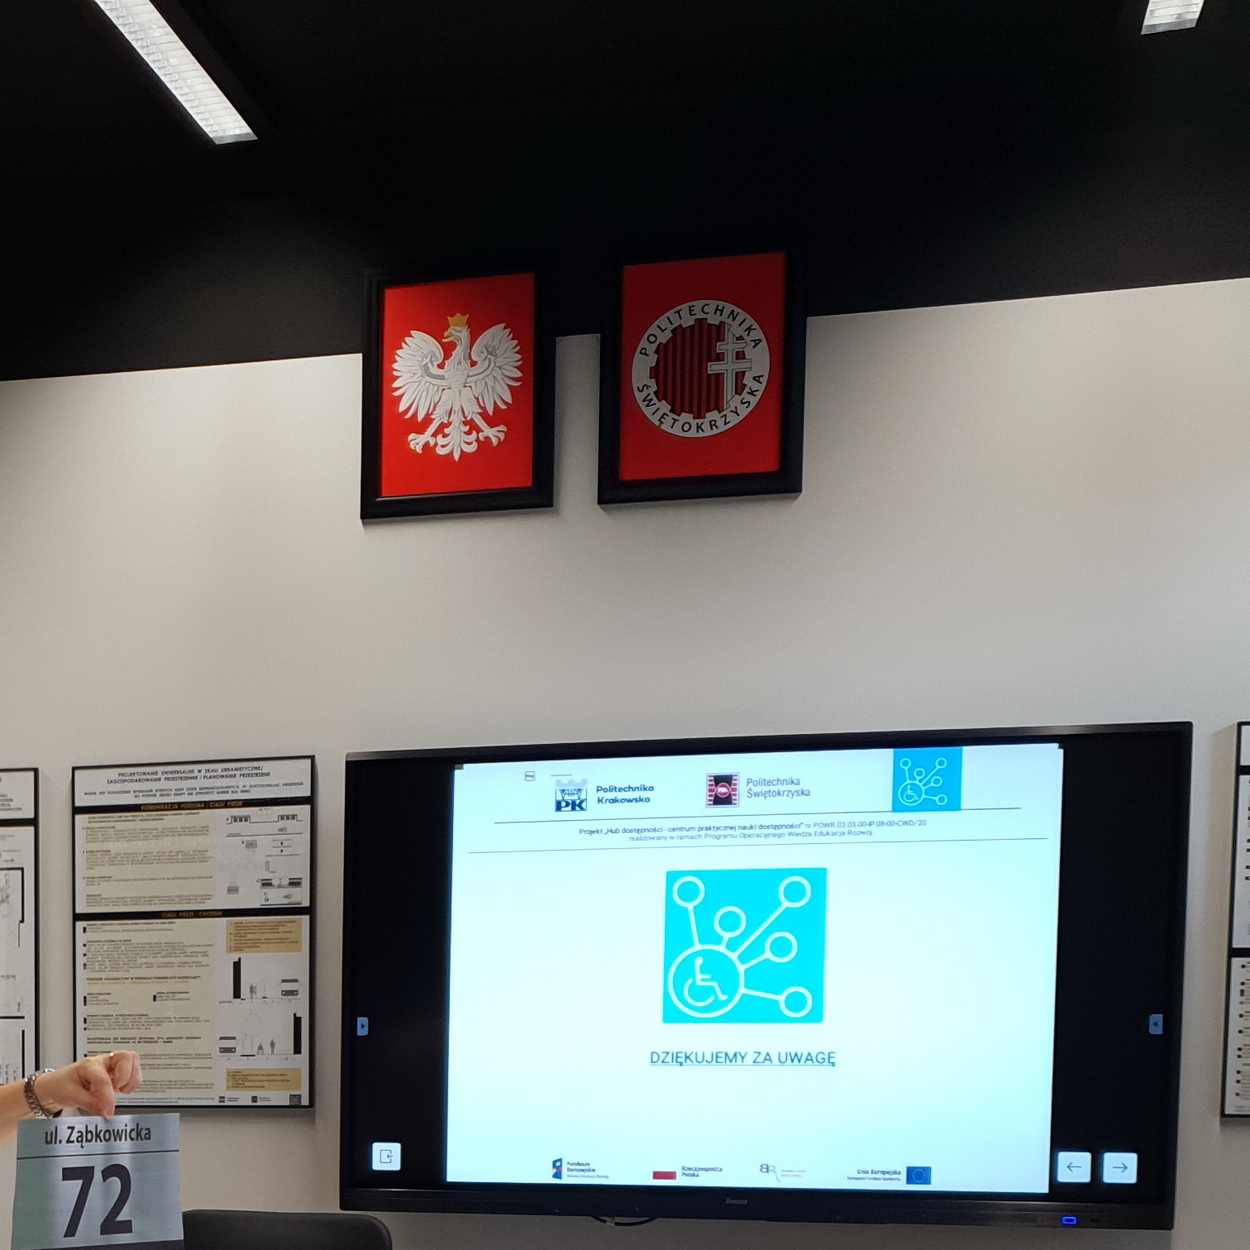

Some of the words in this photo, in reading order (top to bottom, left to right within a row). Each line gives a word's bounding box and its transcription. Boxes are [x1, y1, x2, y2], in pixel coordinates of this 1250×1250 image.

[639, 303, 763, 358] POLITECHNIKA
[637, 373, 765, 433] ŚWIĘTOKRZYSKA
[746, 776, 801, 787] Politechnika
[596, 784, 654, 794] Politechnika
[746, 786, 811, 800] Świętokrzyska
[556, 799, 587, 811] PK
[597, 795, 651, 805] Krakowska
[579, 828, 603, 836] Projekt
[697, 825, 737, 834] praktycznej
[738, 823, 757, 831] nauki
[650, 1051, 747, 1067] DZIĘKUJEMY
[752, 1051, 773, 1065] ZA
[778, 1051, 837, 1068] UWAGĘ
[44, 1126, 63, 1146] ul.
[65, 1123, 152, 1149] Ząbkowicka
[61, 1163, 133, 1239] 72
